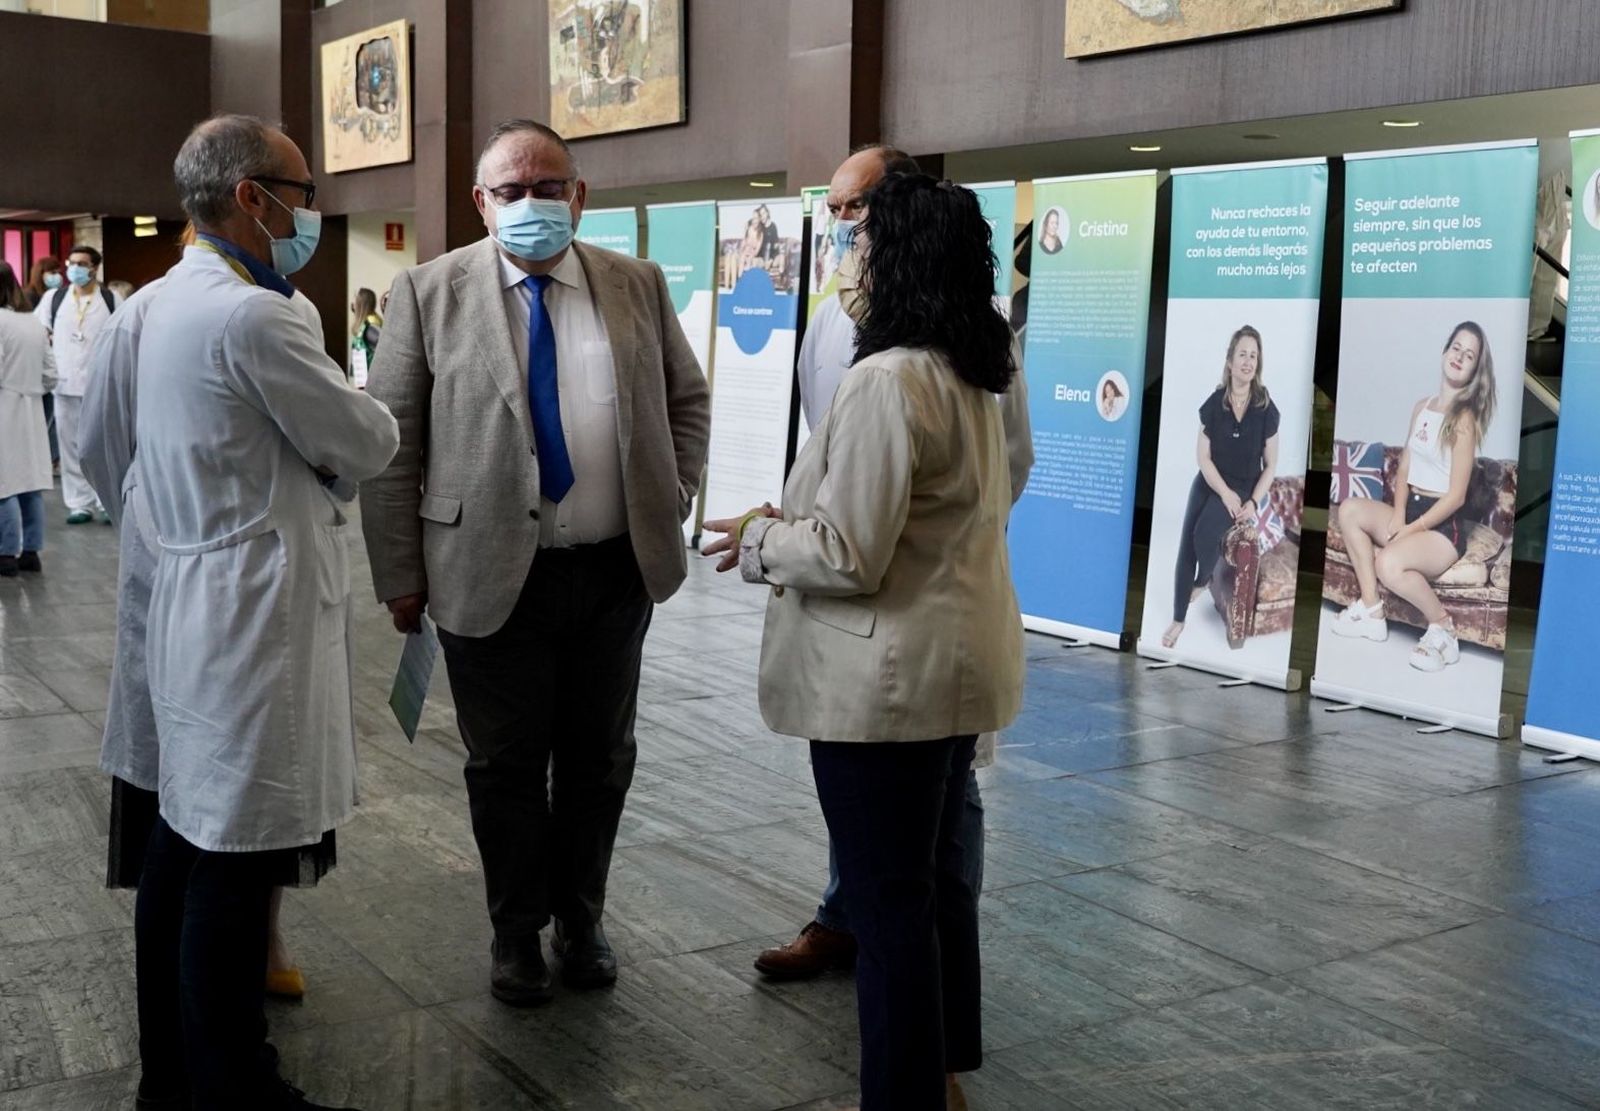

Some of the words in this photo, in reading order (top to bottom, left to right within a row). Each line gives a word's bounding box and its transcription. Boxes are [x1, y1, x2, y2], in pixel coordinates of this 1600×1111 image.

[1211, 207, 1246, 221] Nunca
[1247, 204, 1299, 219] rechaces
[1299, 202, 1312, 217] la
[1354, 198, 1397, 217] Seguir
[1398, 194, 1461, 211] adelante
[1078, 219, 1129, 238] Cristina
[1196, 226, 1230, 242] ayuda
[1231, 225, 1247, 239] de
[1247, 225, 1260, 238] tu
[1260, 223, 1310, 237] entorno,
[1352, 219, 1409, 234] siempre,
[1411, 215, 1431, 231] sin
[1432, 217, 1461, 233] que
[1461, 213, 1483, 229] los
[1186, 247, 1206, 259] con
[1206, 244, 1223, 258] los
[1223, 244, 1261, 258] demás
[1262, 242, 1308, 261] llegarás
[1351, 238, 1416, 256] pequeños
[1417, 236, 1493, 255] problemas
[1216, 262, 1254, 277] mucho
[1254, 260, 1280, 276] más
[1279, 260, 1307, 281] lejos
[1350, 260, 1365, 274] te
[1365, 258, 1418, 274] afecten
[1055, 384, 1091, 402] Elena
